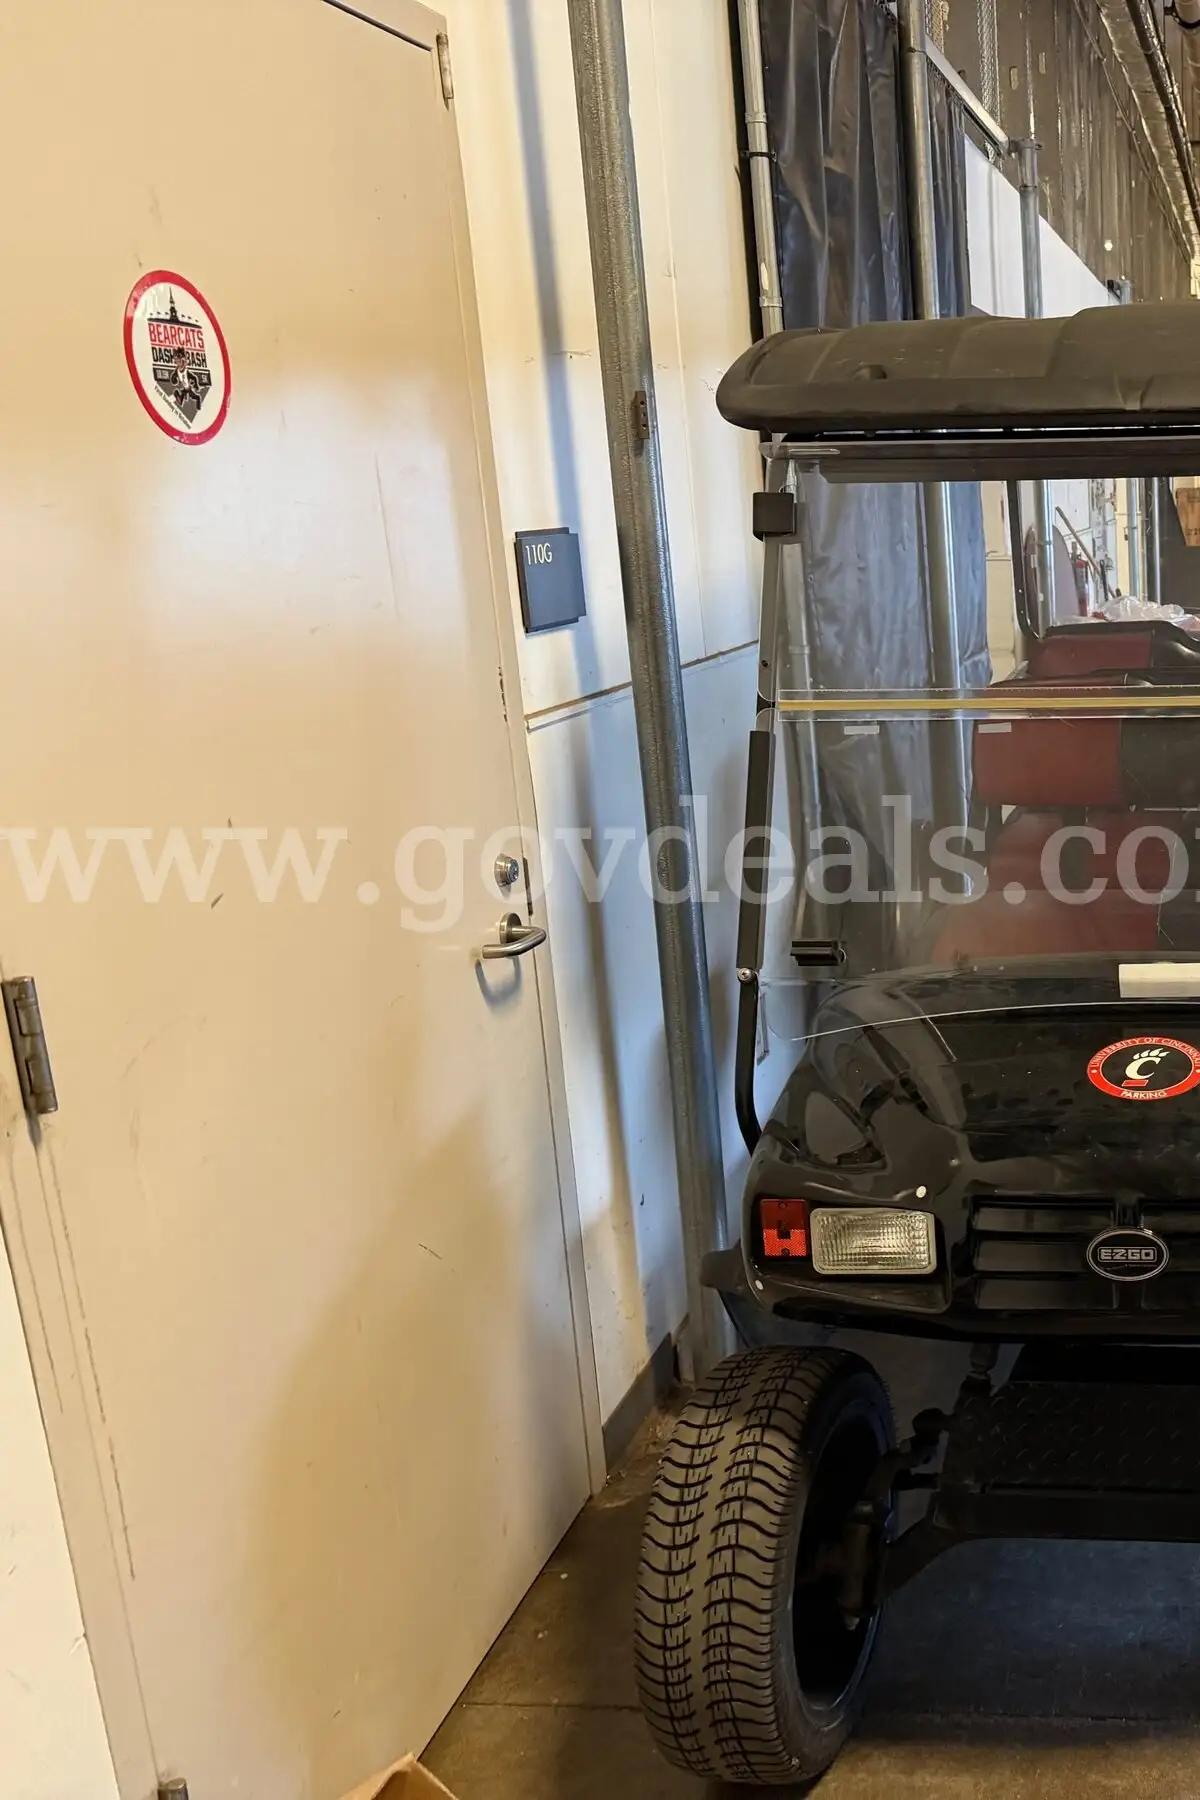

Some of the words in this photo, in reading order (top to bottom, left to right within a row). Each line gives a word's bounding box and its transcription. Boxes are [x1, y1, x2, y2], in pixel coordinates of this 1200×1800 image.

[148, 322, 205, 349] BEARCATS
[151, 346, 177, 364] DASH
[525, 542, 553, 566] 110G
[1091, 1038, 1140, 1067] UNIVERSITY
[1143, 1037, 1160, 1045] OF
[1120, 1090, 1168, 1100] PARKING
